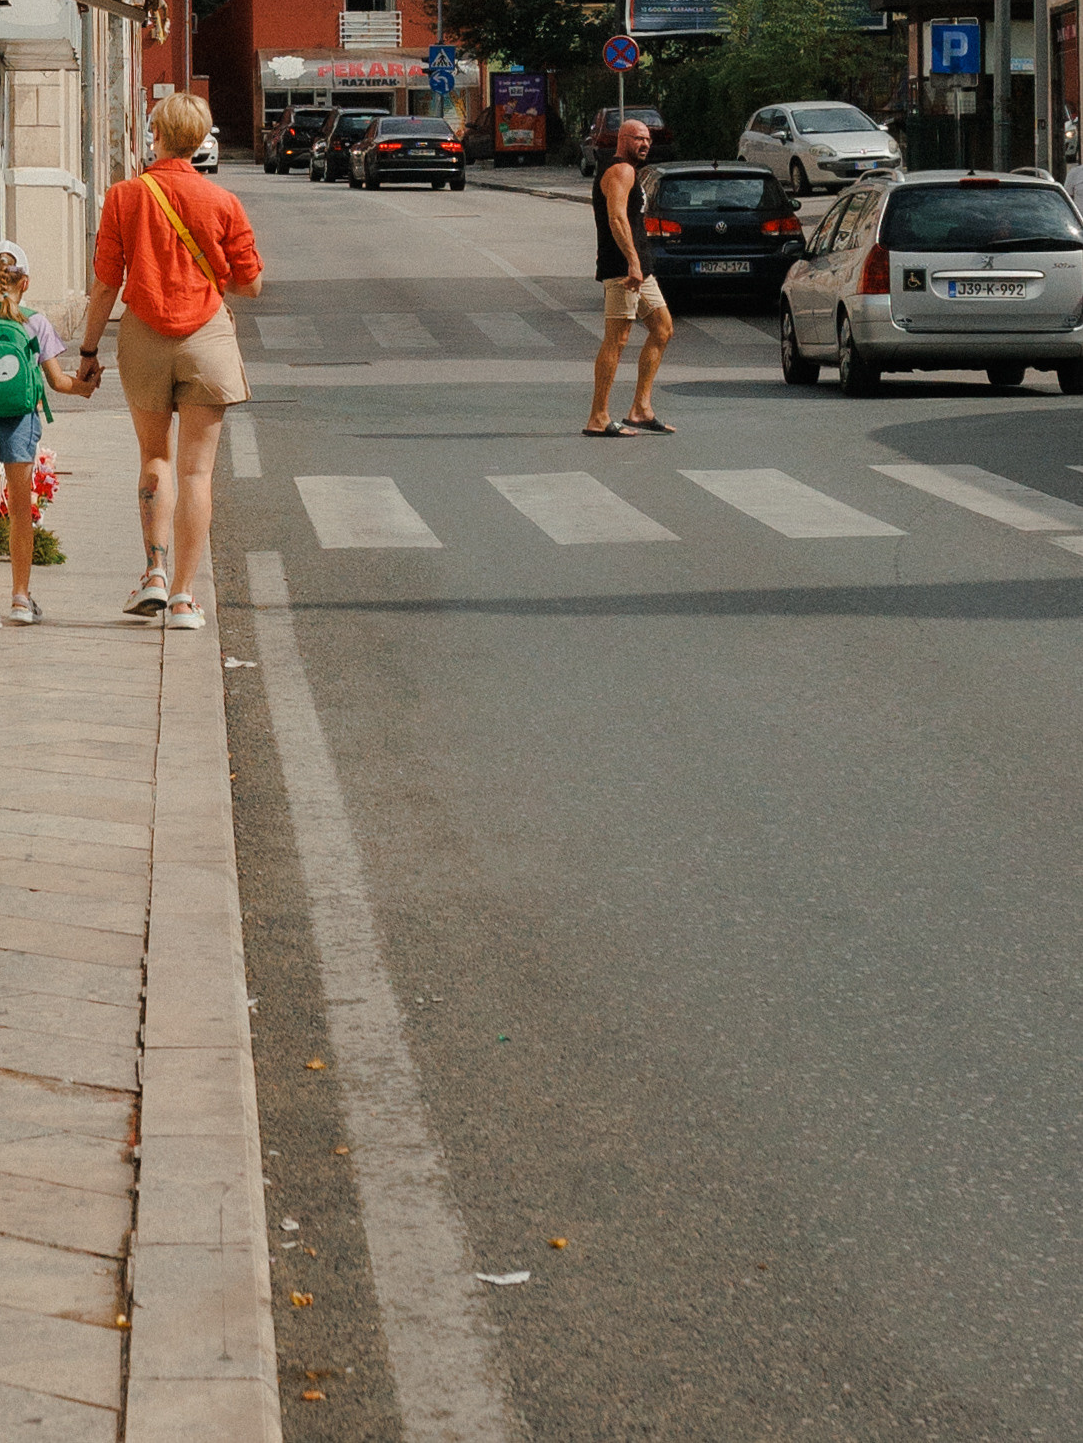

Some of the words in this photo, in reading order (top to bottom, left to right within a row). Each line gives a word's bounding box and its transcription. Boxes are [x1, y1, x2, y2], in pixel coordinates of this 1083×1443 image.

[941, 30, 969, 66] P
[317, 62, 429, 78] PEKARA
[957, 282, 1024, 296] J39-K-992
